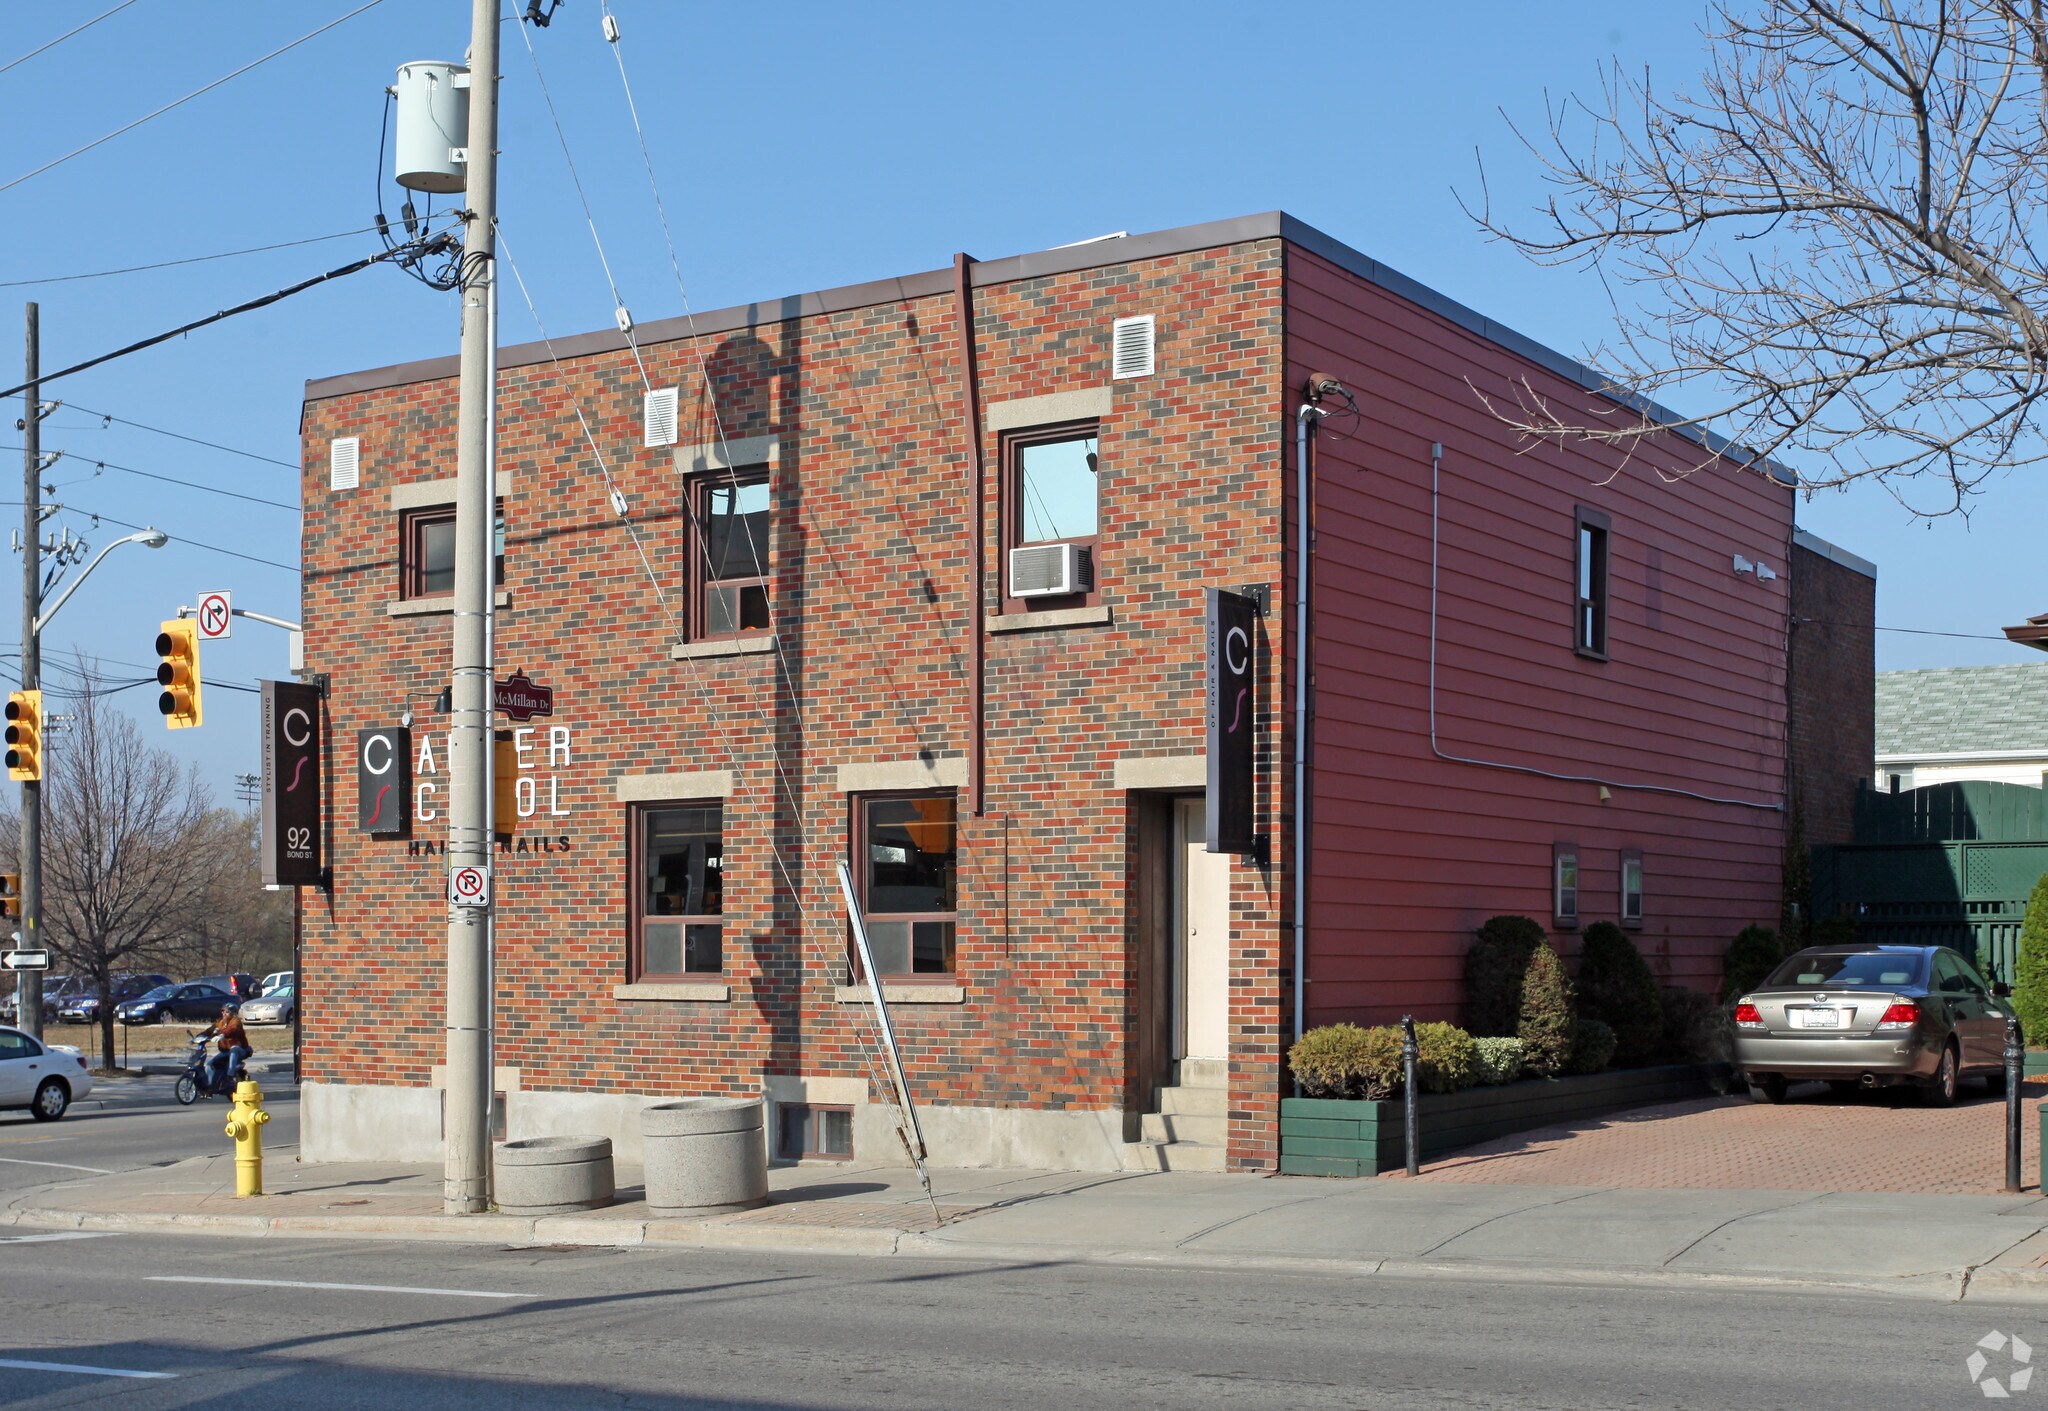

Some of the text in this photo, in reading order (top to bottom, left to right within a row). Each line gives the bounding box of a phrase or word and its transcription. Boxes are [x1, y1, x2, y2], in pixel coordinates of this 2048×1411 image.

[1226, 626, 1248, 675] C
[494, 692, 549, 709] McMillan Dr
[283, 708, 310, 747] C
[1210, 714, 1216, 728] OF
[265, 744, 271, 753] IN
[287, 827, 310, 850] 92
[408, 836, 571, 857] HAI NAILS
[286, 851, 304, 859] BOND
[464, 875, 477, 890] P
